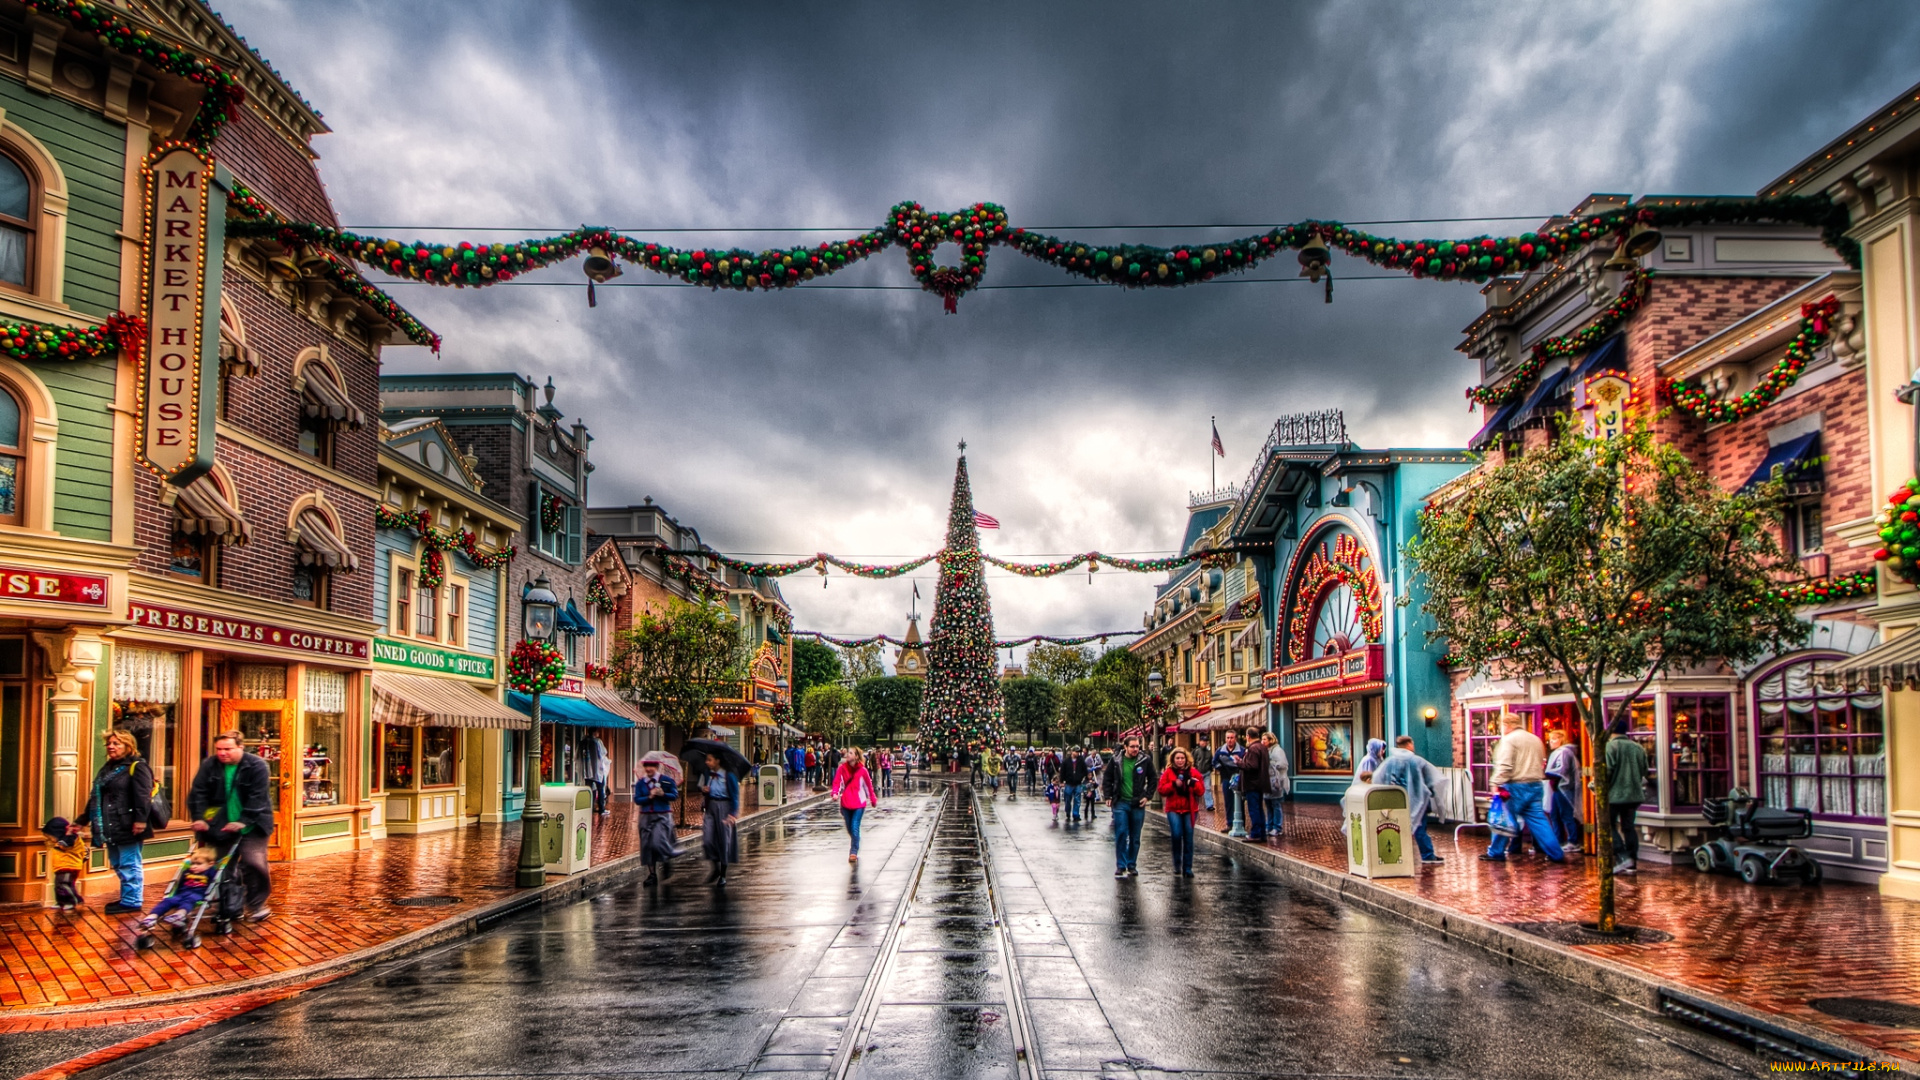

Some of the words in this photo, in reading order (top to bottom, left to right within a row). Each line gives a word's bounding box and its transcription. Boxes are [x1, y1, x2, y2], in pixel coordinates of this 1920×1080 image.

[162, 170, 197, 312] MARKET
[156, 327, 188, 447] HOUSE
[0, 572, 61, 598] SE
[1332, 532, 1384, 640] ARCADE
[131, 606, 265, 642] PRESERVES
[289, 632, 354, 655] COFFEE
[374, 643, 407, 662] NNED
[409, 649, 444, 668] GOODS
[457, 659, 487, 675] SPICES
[1286, 664, 1338, 684] DISNEYLAND
